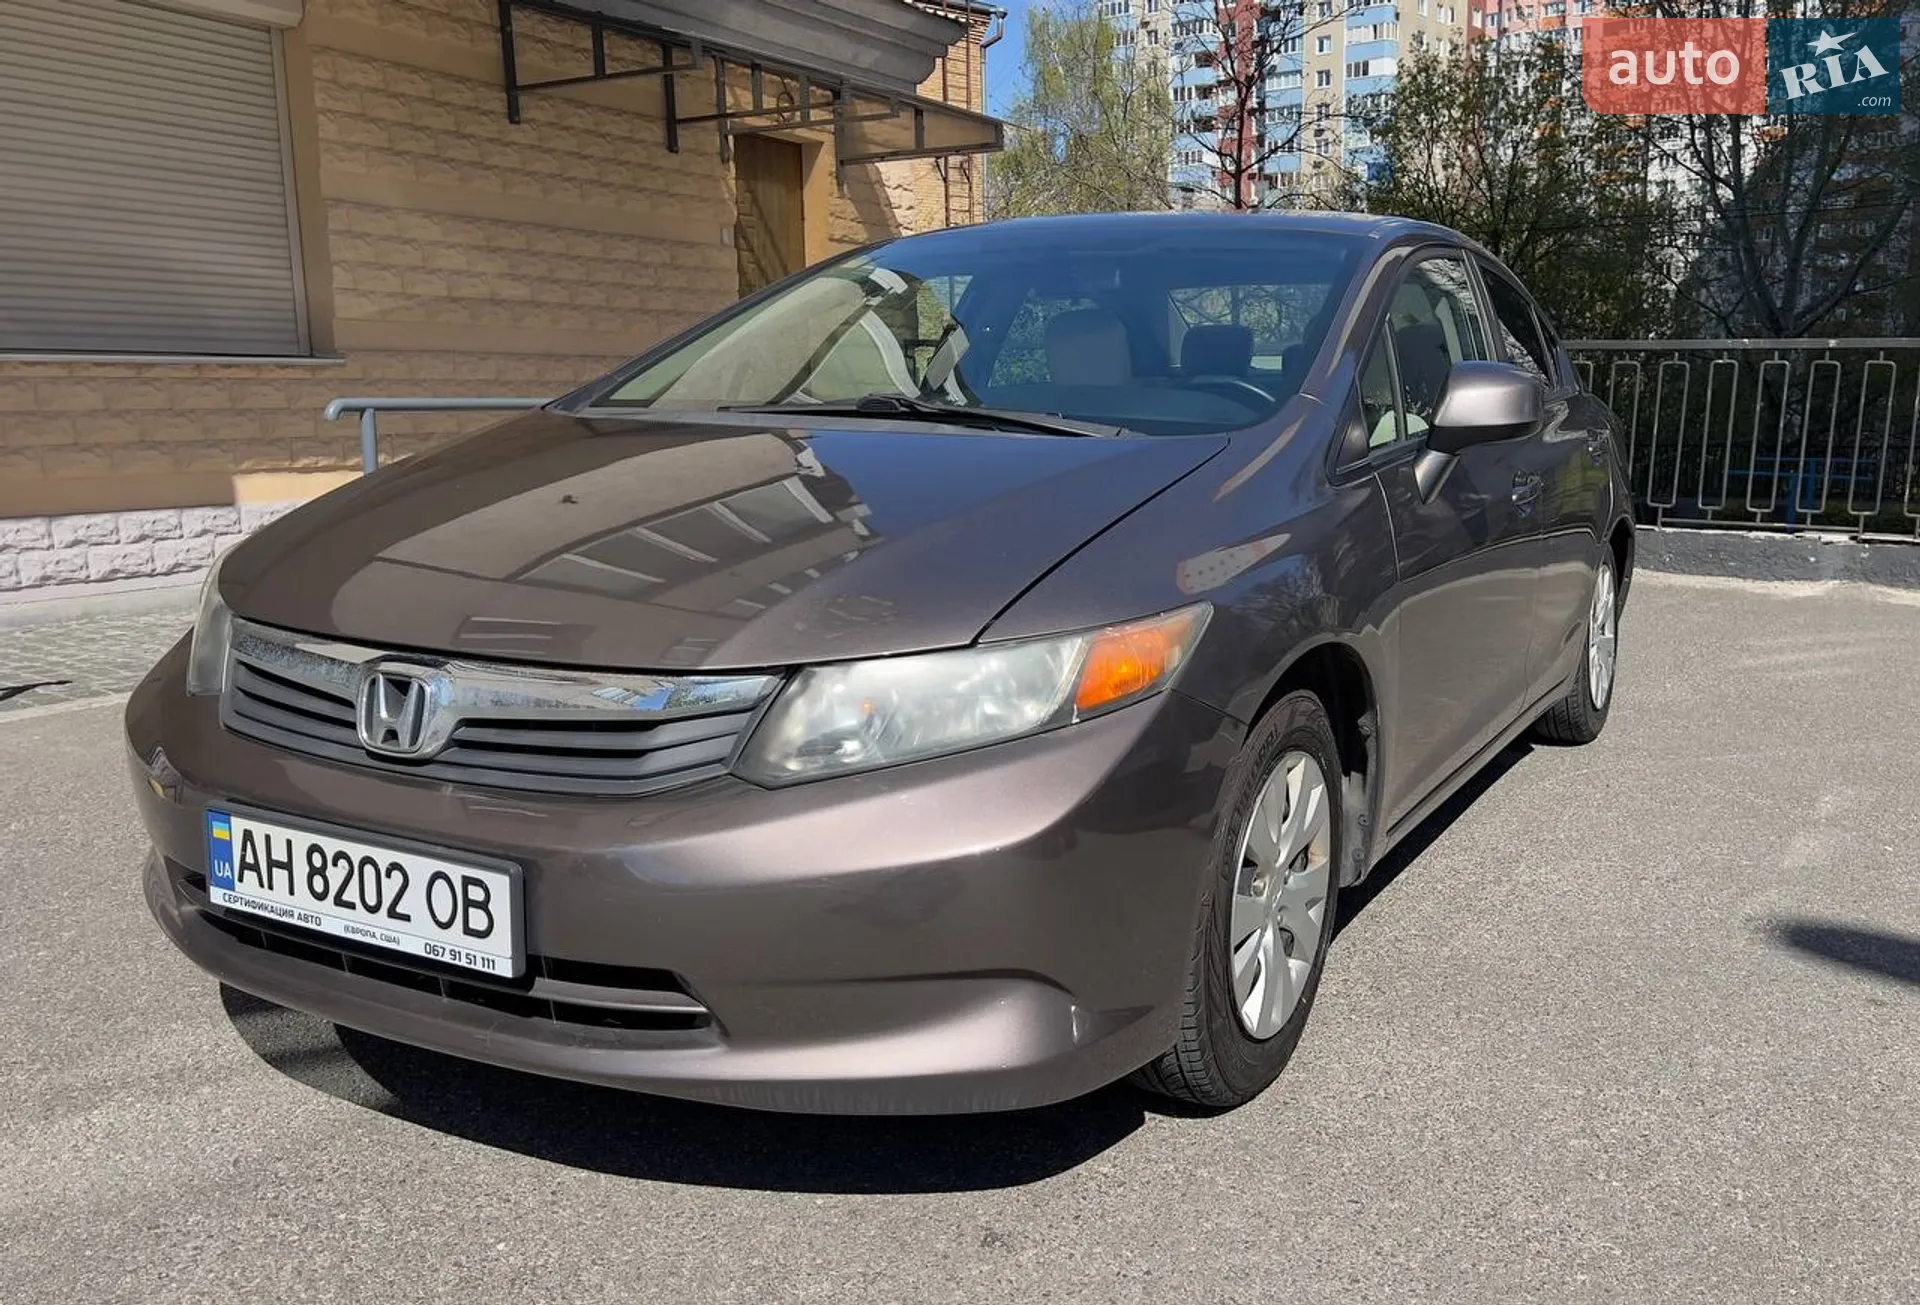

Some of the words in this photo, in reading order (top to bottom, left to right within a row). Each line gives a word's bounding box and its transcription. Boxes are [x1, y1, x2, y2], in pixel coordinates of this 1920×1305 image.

[214, 858, 233, 880] UA
[236, 828, 296, 896] AH
[306, 842, 412, 923] 8202
[425, 870, 495, 939] OB
[222, 892, 295, 919] СЕРТИФИКАЦИЯ
[297, 911, 322, 927] АВТО
[424, 942, 446, 958] 067
[449, 948, 462, 962] 91
[465, 951, 477, 966] 51
[481, 956, 496, 971] 111
